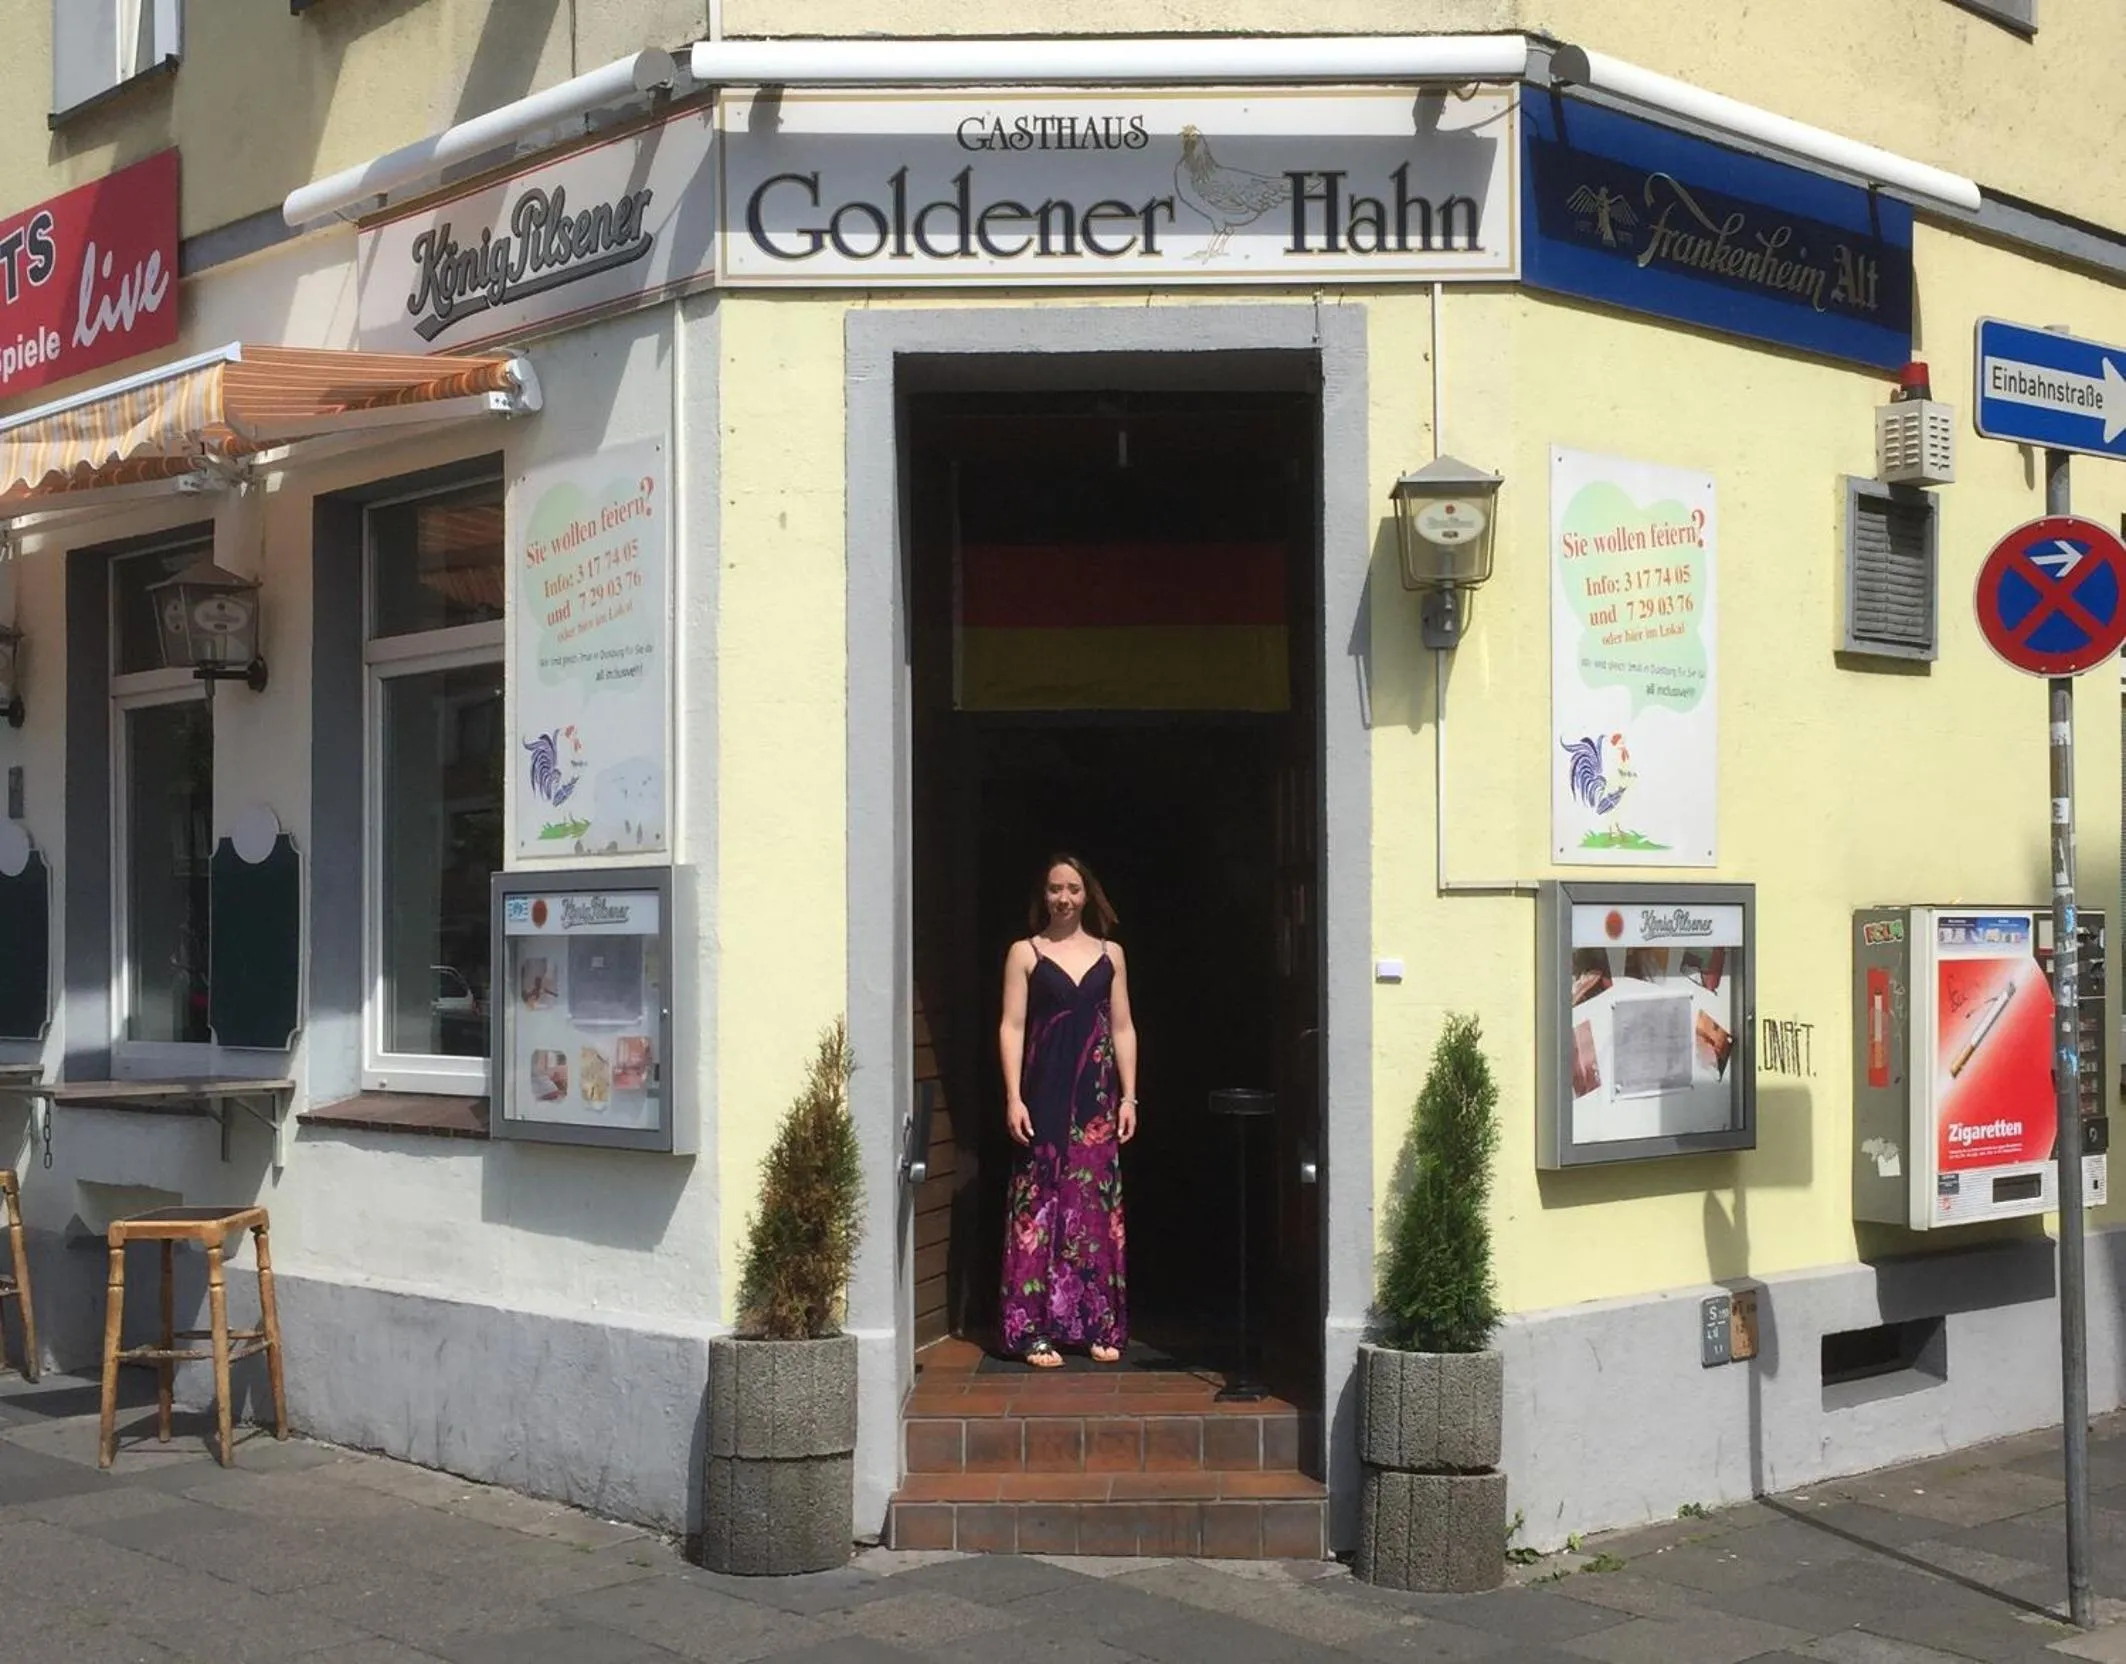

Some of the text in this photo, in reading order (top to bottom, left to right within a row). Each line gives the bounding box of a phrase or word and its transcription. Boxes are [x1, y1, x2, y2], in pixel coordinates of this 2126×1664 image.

[956, 114, 1150, 151] GASTHAUS
[745, 161, 1486, 261] Goldener Hahn
[408, 184, 655, 306] König Pilsener
[1637, 172, 1880, 312] Frankenheim Alt
[72, 241, 170, 348] live
[0, 326, 61, 382] piele
[1992, 366, 2104, 410] Einbahnstraße
[526, 543, 548, 570] Sie
[552, 520, 597, 556] wollen
[1562, 509, 1705, 559] Sie wollen feiern?
[544, 571, 574, 598] Info:
[1585, 564, 1692, 597] Info: 3 17 74 05
[546, 600, 572, 627] und
[1589, 594, 1694, 626] und 7 29 03 76
[1948, 1119, 2023, 1146] Zigaretten
